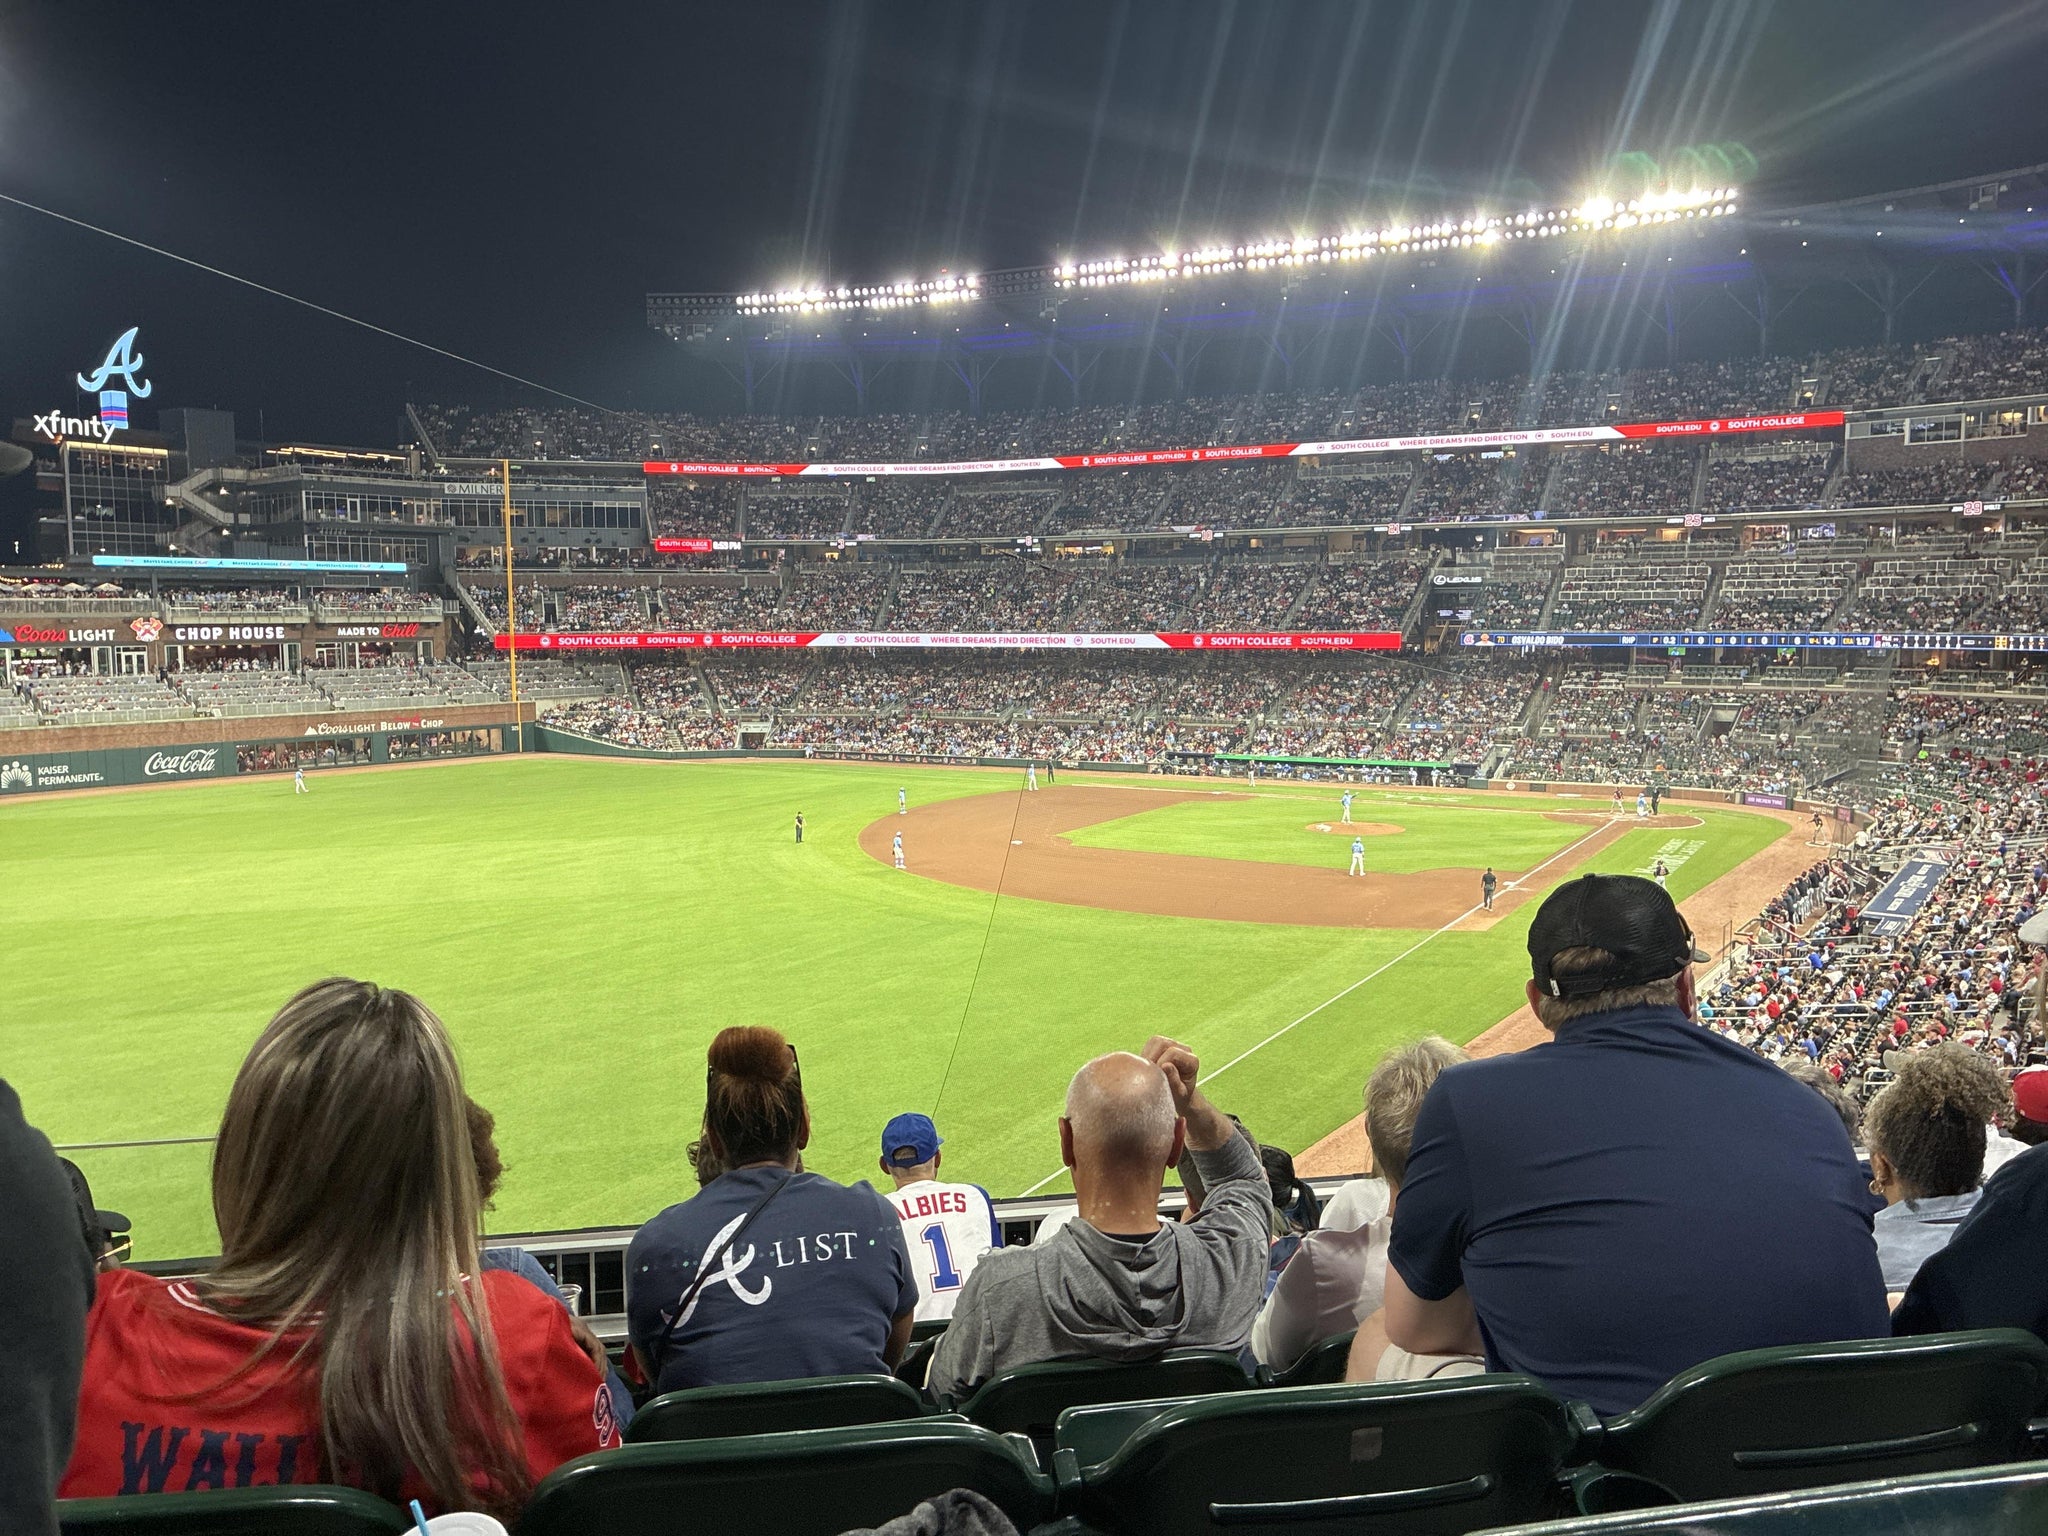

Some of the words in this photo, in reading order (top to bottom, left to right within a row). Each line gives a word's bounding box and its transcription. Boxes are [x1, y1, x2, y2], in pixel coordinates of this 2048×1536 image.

[33, 409, 116, 443] xfinity
[1728, 420, 1761, 429] SOUTH
[1762, 416, 1804, 426] COLLEGE
[1656, 424, 1702, 432] SOUTH.EDU
[1551, 430, 1593, 438] SOUTH.EDU
[1357, 441, 1390, 449] COLLEGE
[1399, 438, 1428, 447] WHERE
[1430, 437, 1463, 445] DREAMS
[1464, 435, 1483, 444] FIND
[1484, 433, 1528, 442] DIRECTION
[1153, 453, 1186, 461] SOUTH.EDU
[1205, 449, 1230, 458] SOUTH
[1231, 447, 1262, 456] COLLEGE
[1094, 456, 1117, 464] SOUTH
[1118, 454, 1147, 463] COLLEGE
[708, 465, 738, 473] COLLEGE
[459, 484, 503, 494] MILNER
[1963, 501, 1983, 516] 29
[1684, 513, 1702, 527] 25
[15, 624, 67, 643] Coors
[69, 629, 115, 641] LIGHT
[175, 627, 223, 640] CHOP
[229, 627, 285, 640] HOUSE
[337, 627, 365, 636] MADE
[366, 627, 380, 636] TO
[381, 623, 421, 638] Chill
[558, 636, 593, 645] SOUTH
[594, 636, 639, 645] COLLEGE
[647, 636, 695, 644] SOUTH.EDU
[721, 635, 754, 644] SOUTH
[755, 635, 796, 644] COLLEGE
[854, 635, 885, 643] SOUTH
[886, 635, 921, 643] COLLEGE
[962, 636, 997, 644] DREAMS
[998, 636, 1019, 644] FIND
[1020, 636, 1066, 644] DIRECTION
[1210, 636, 1245, 646] SOUTH
[1246, 636, 1292, 646] COLLEGE
[1300, 636, 1353, 645] SOUTH.EDU
[1511, 636, 1545, 645] OSVALDO
[317, 722, 349, 735] Coors
[349, 723, 375, 733] LIGHT
[381, 721, 411, 731] BELOW
[421, 719, 444, 728] CHOP
[144, 748, 219, 776] Coca-Cola
[38, 765, 69, 775] KAISER
[39, 773, 101, 785] PERMANENTE
[920, 1221, 963, 1293] 1
[660, 1212, 773, 1329] A
[772, 1232, 858, 1268] LIST
